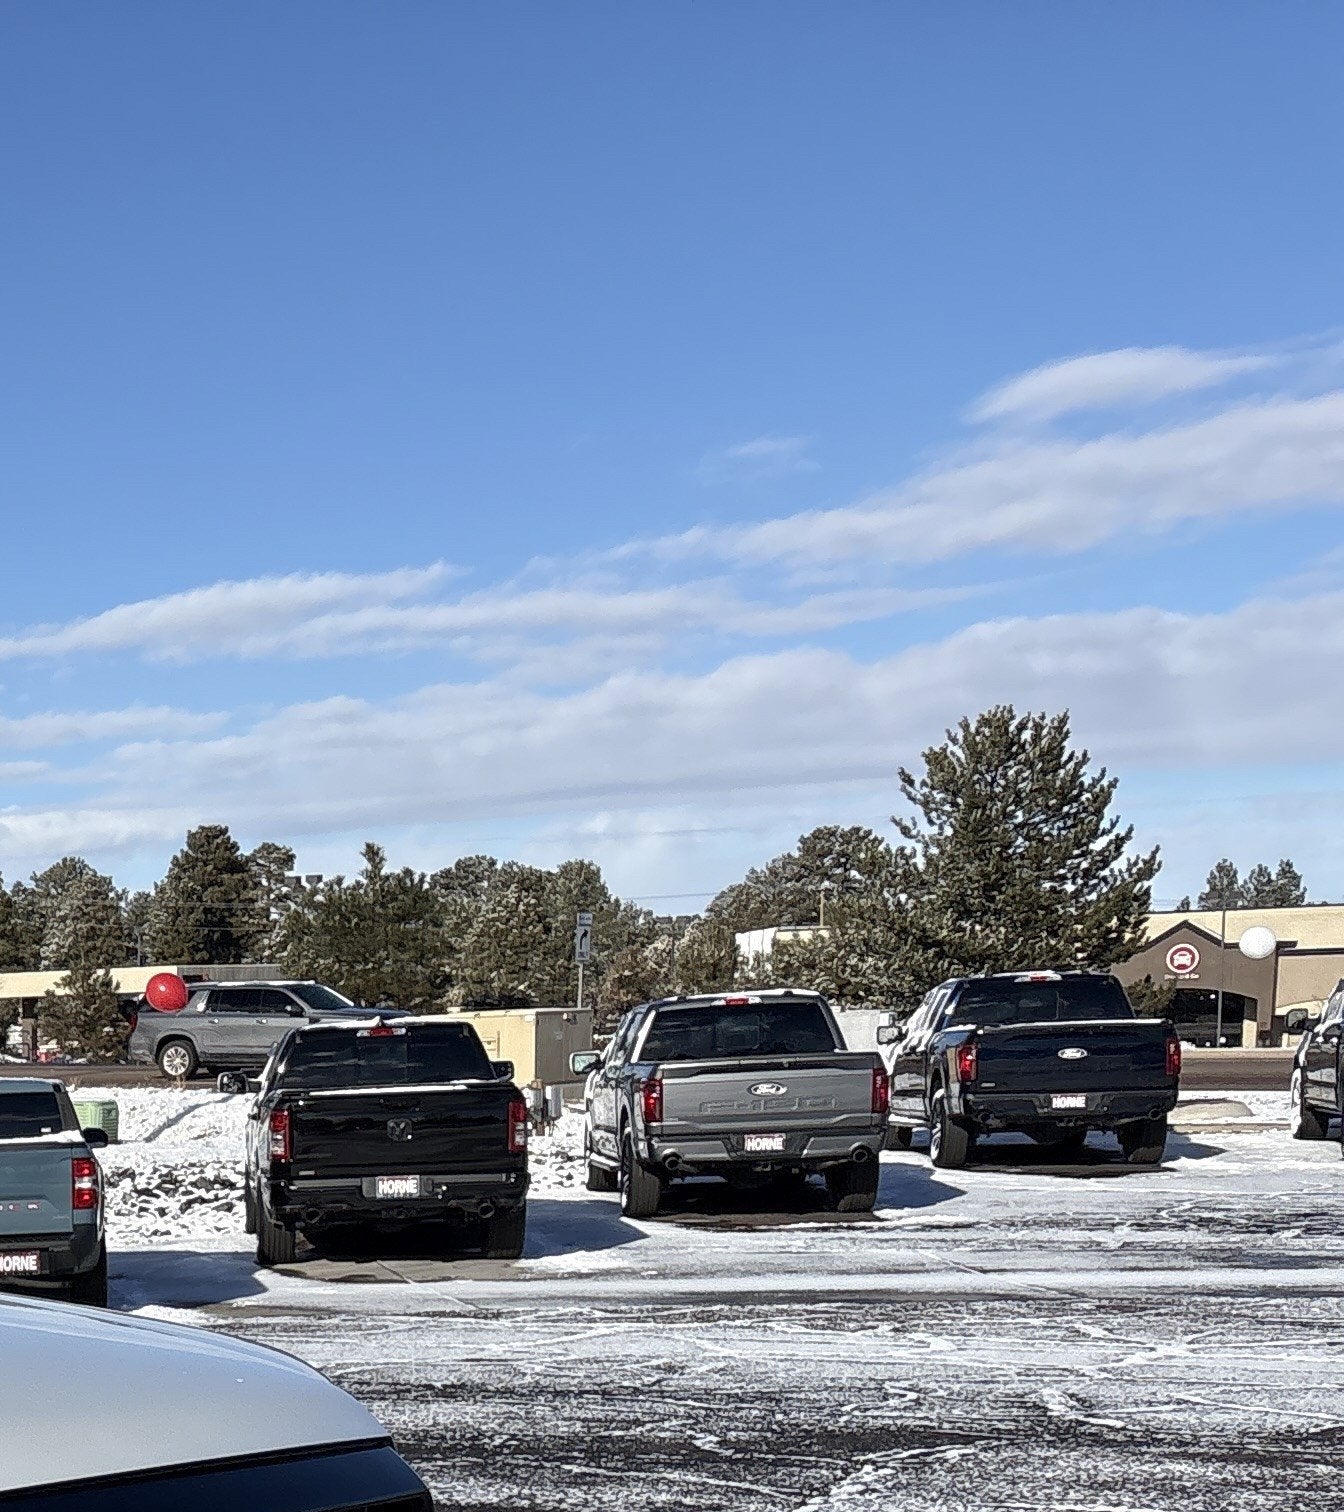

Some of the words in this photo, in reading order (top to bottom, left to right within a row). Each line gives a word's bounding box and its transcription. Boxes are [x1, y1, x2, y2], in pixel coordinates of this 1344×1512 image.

[1052, 1096, 1086, 1109] HORNE
[746, 1137, 784, 1151] HORNE
[378, 1179, 418, 1195] HORNE
